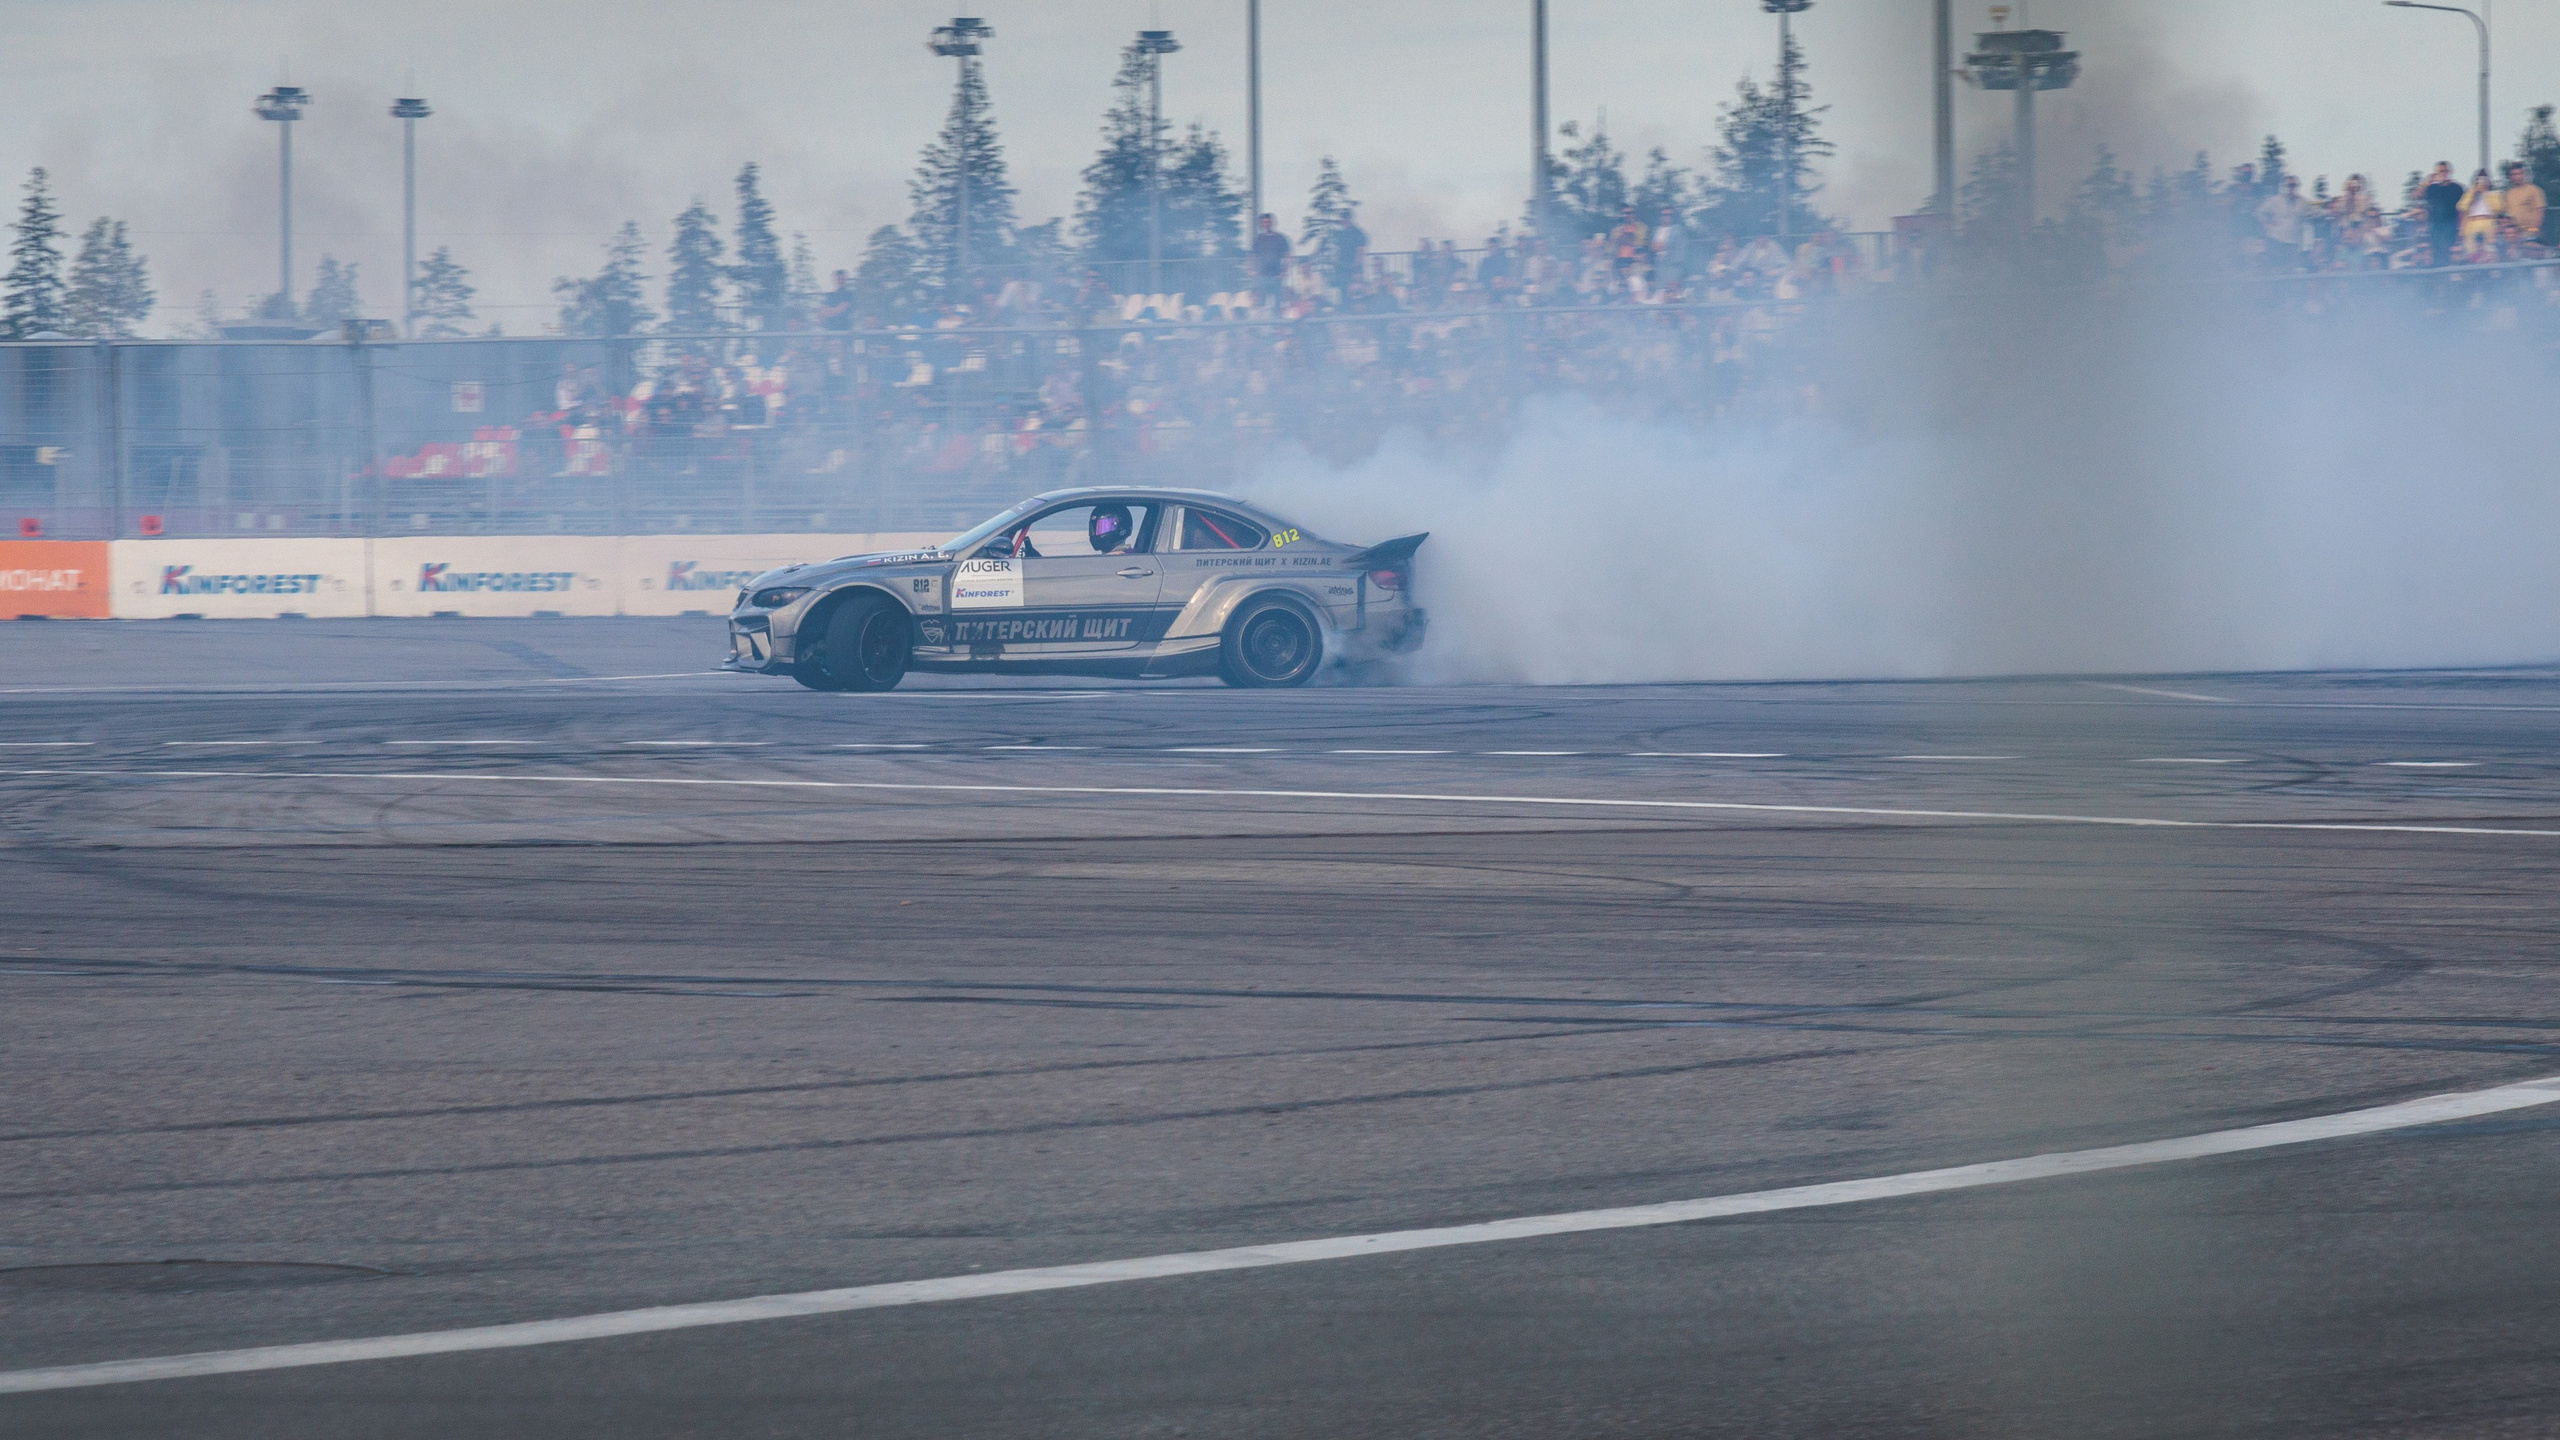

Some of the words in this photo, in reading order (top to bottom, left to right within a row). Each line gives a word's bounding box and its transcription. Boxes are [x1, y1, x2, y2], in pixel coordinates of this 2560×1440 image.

[1272, 528, 1300, 548] 812
[884, 553, 918, 563] KIZIN
[1196, 556, 1252, 568] ПИТЕРСКИЙ
[1255, 557, 1277, 567] ЩИТ
[1293, 557, 1332, 566] KIZIN.AE
[961, 560, 1012, 573] AUGER
[913, 578, 930, 593] 812
[955, 588, 1010, 598] KINFOREST
[955, 615, 1078, 641] ПИТЕРСКИЙ
[1082, 618, 1133, 640] ЩИТ
